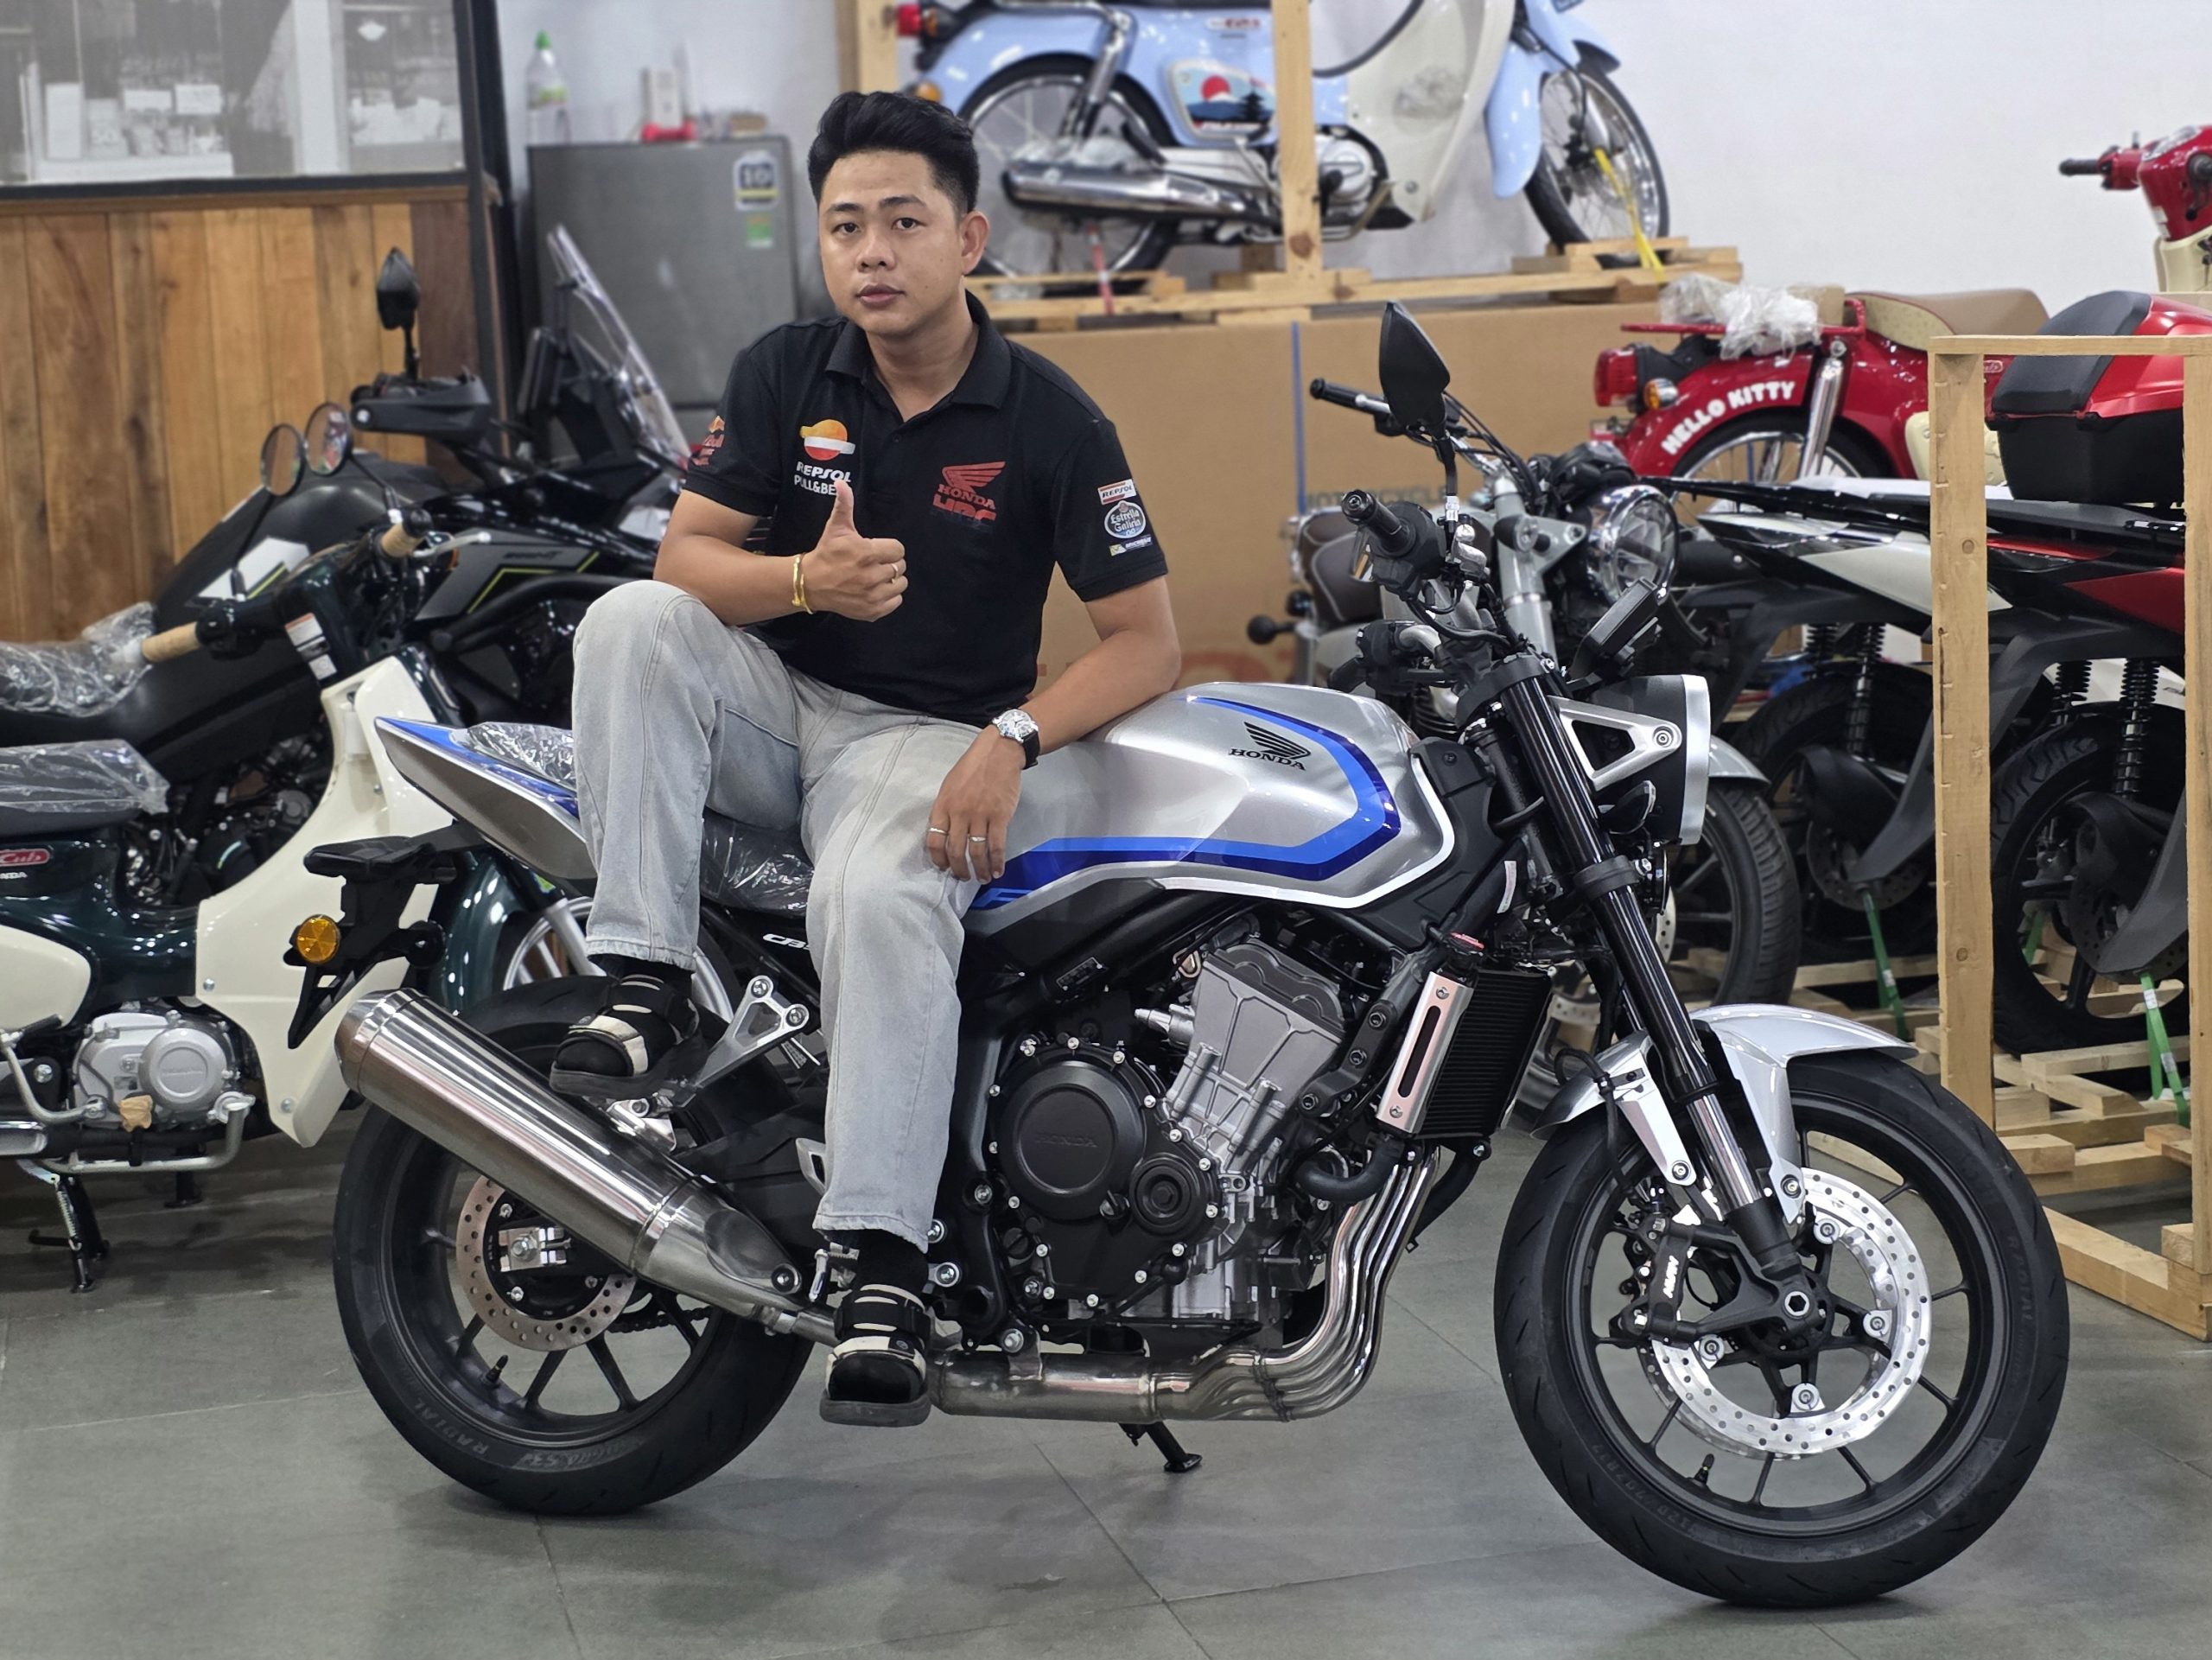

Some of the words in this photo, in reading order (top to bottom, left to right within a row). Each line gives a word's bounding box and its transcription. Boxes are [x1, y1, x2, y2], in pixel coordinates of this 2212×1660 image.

[1661, 398, 1726, 455] HELLO
[1727, 381, 1796, 410] KITTY
[796, 461, 852, 483] REPSOL
[793, 474, 838, 496] PULL&BE
[937, 483, 996, 510] HONDA
[1103, 484, 1133, 499] REPSOL
[1229, 748, 1306, 771] HONDA
[414, 1397, 489, 1454] RADIAL
